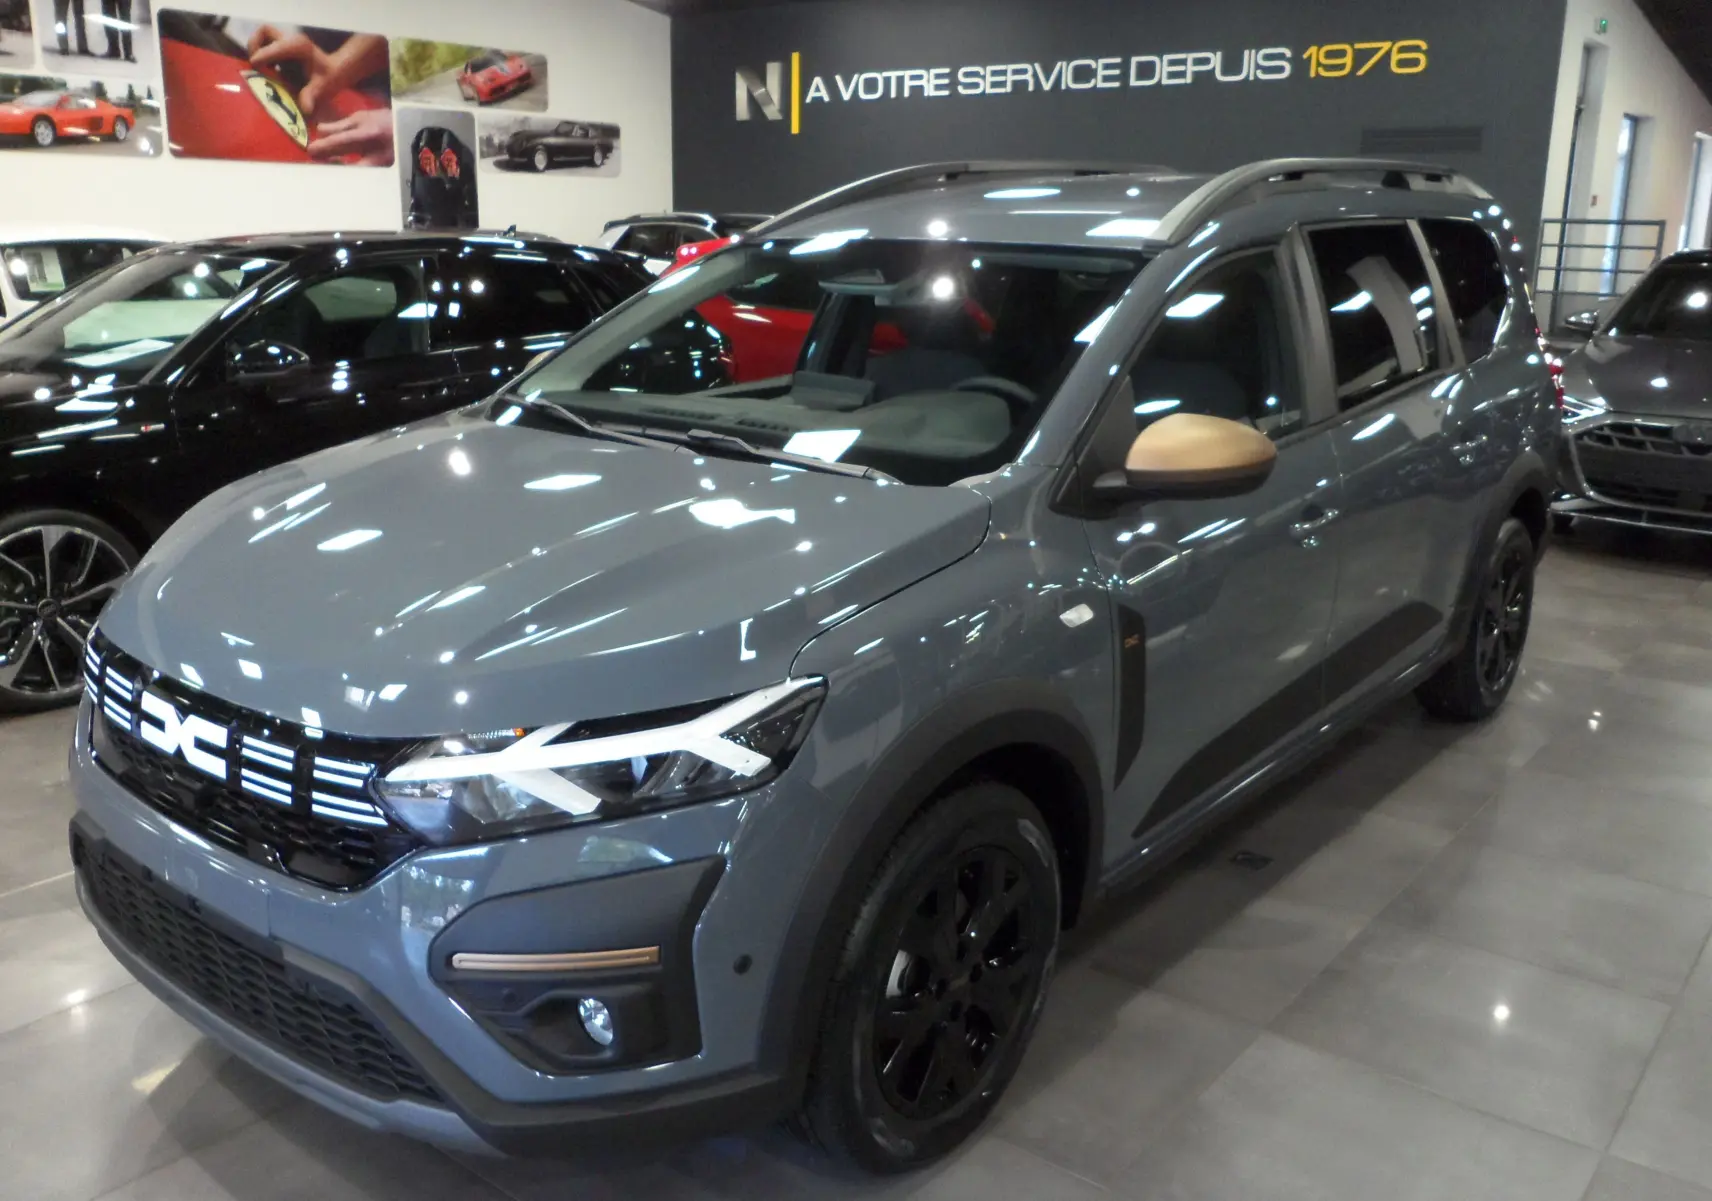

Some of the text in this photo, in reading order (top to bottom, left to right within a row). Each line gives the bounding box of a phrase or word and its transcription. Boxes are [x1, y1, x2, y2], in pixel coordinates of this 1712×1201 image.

[806, 40, 1429, 104] A VOTRE SERVICE DEPUIS 1976
